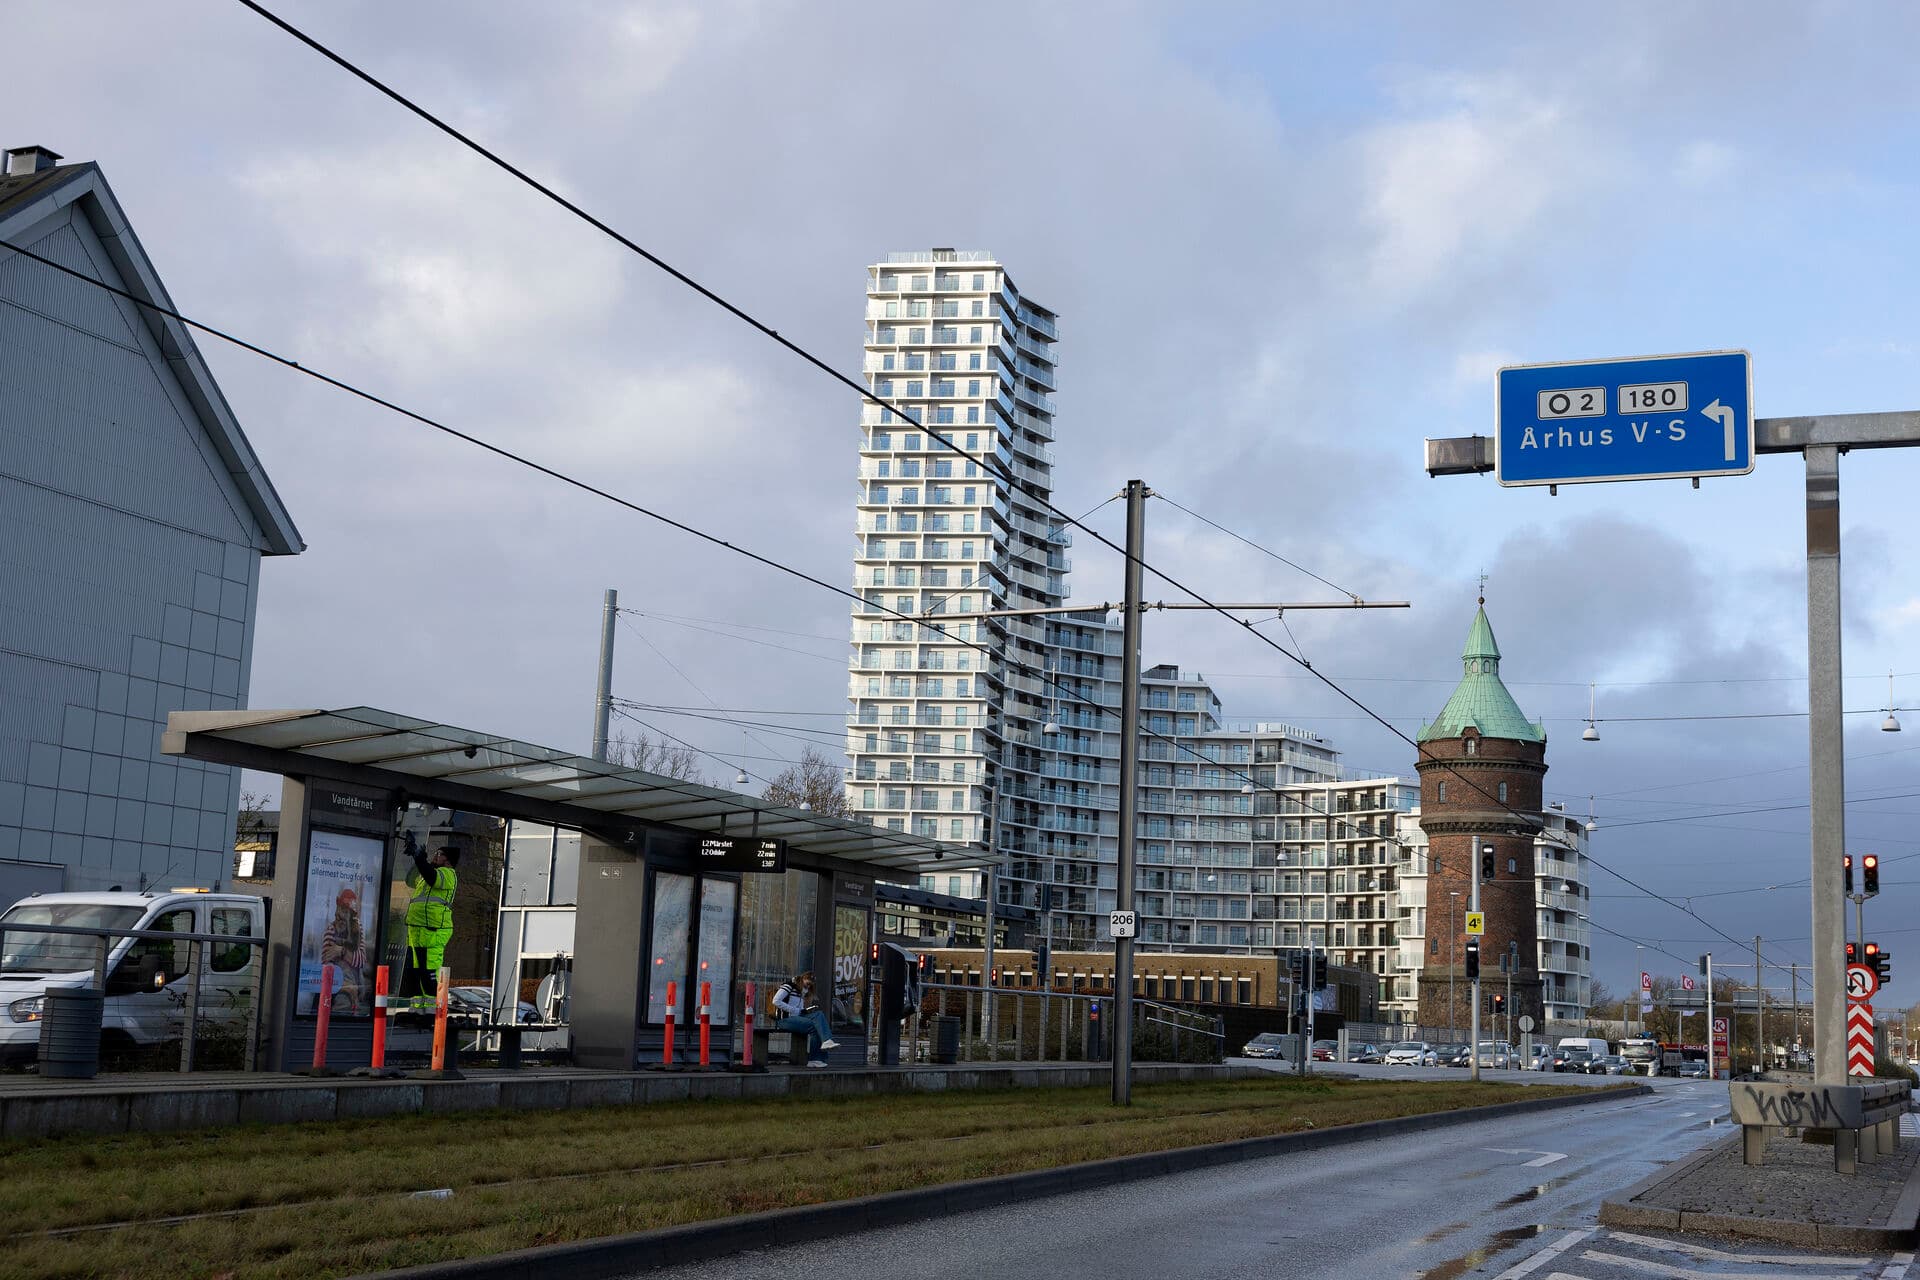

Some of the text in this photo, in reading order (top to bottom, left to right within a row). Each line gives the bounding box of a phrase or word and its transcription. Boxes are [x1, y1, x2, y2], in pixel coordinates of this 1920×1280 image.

[1549, 393, 1594, 415] O 2
[1629, 388, 1676, 408] 180
[1520, 426, 1614, 449] Århus
[332, 793, 374, 810] Vandtårnet
[628, 831, 635, 841] 2
[312, 855, 321, 864] En
[1111, 915, 1133, 925] 206
[1119, 927, 1126, 935] 8
[835, 929, 864, 957] 50%
[835, 954, 864, 983] 50%
